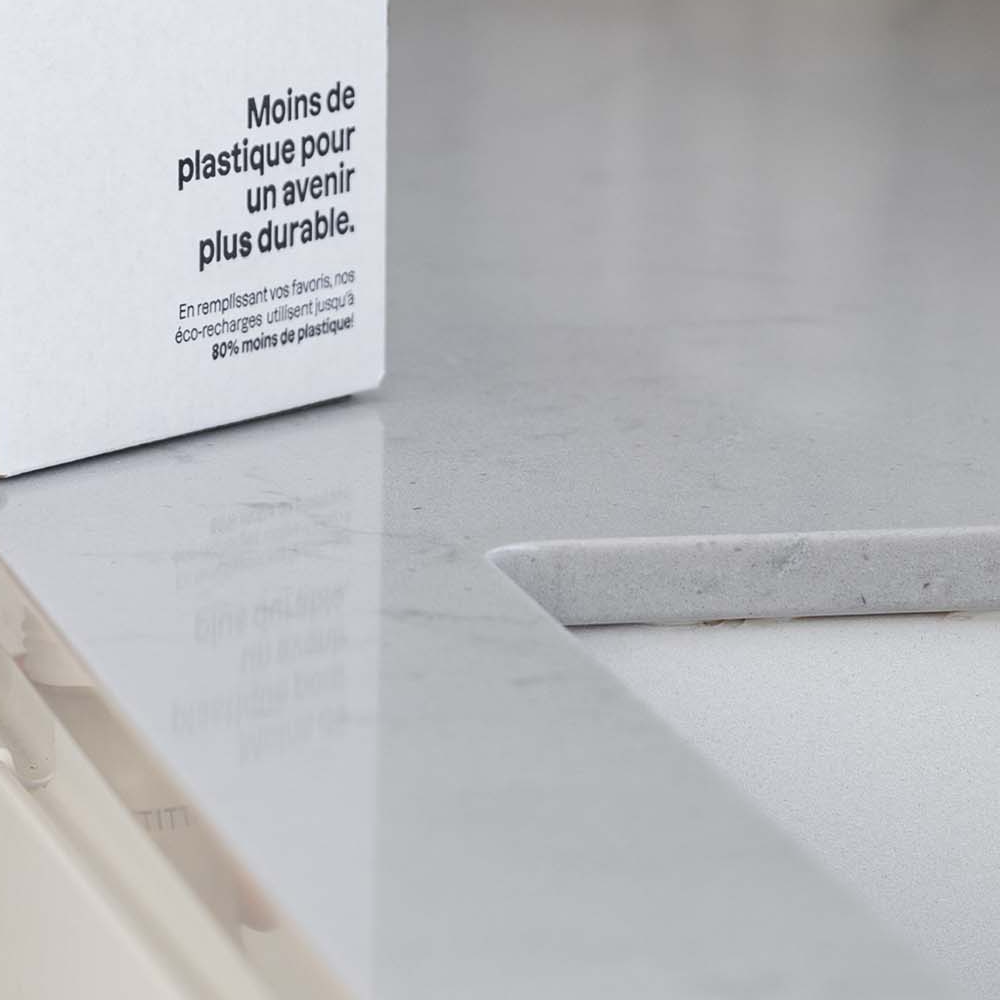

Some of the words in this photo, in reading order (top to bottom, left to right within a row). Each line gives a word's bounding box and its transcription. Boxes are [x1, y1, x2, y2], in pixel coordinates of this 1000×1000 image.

[247, 87, 322, 129] Moins
[326, 81, 355, 113] de
[178, 137, 295, 191] plastique
[301, 126, 355, 167] pour
[247, 183, 276, 214] un
[282, 161, 355, 206] avenir
[199, 230, 252, 272] plus
[257, 207, 354, 253] durable.
[179, 303, 195, 320] En
[197, 287, 268, 316] remplissant
[269, 284, 289, 300] vos
[292, 273, 333, 296] favoris,
[334, 269, 356, 286] nos
[175, 313, 263, 344] éco-recharges
[266, 302, 313, 325] utilisent
[211, 340, 240, 360] 80%
[241, 332, 278, 353] moins
[280, 328, 295, 345] de
